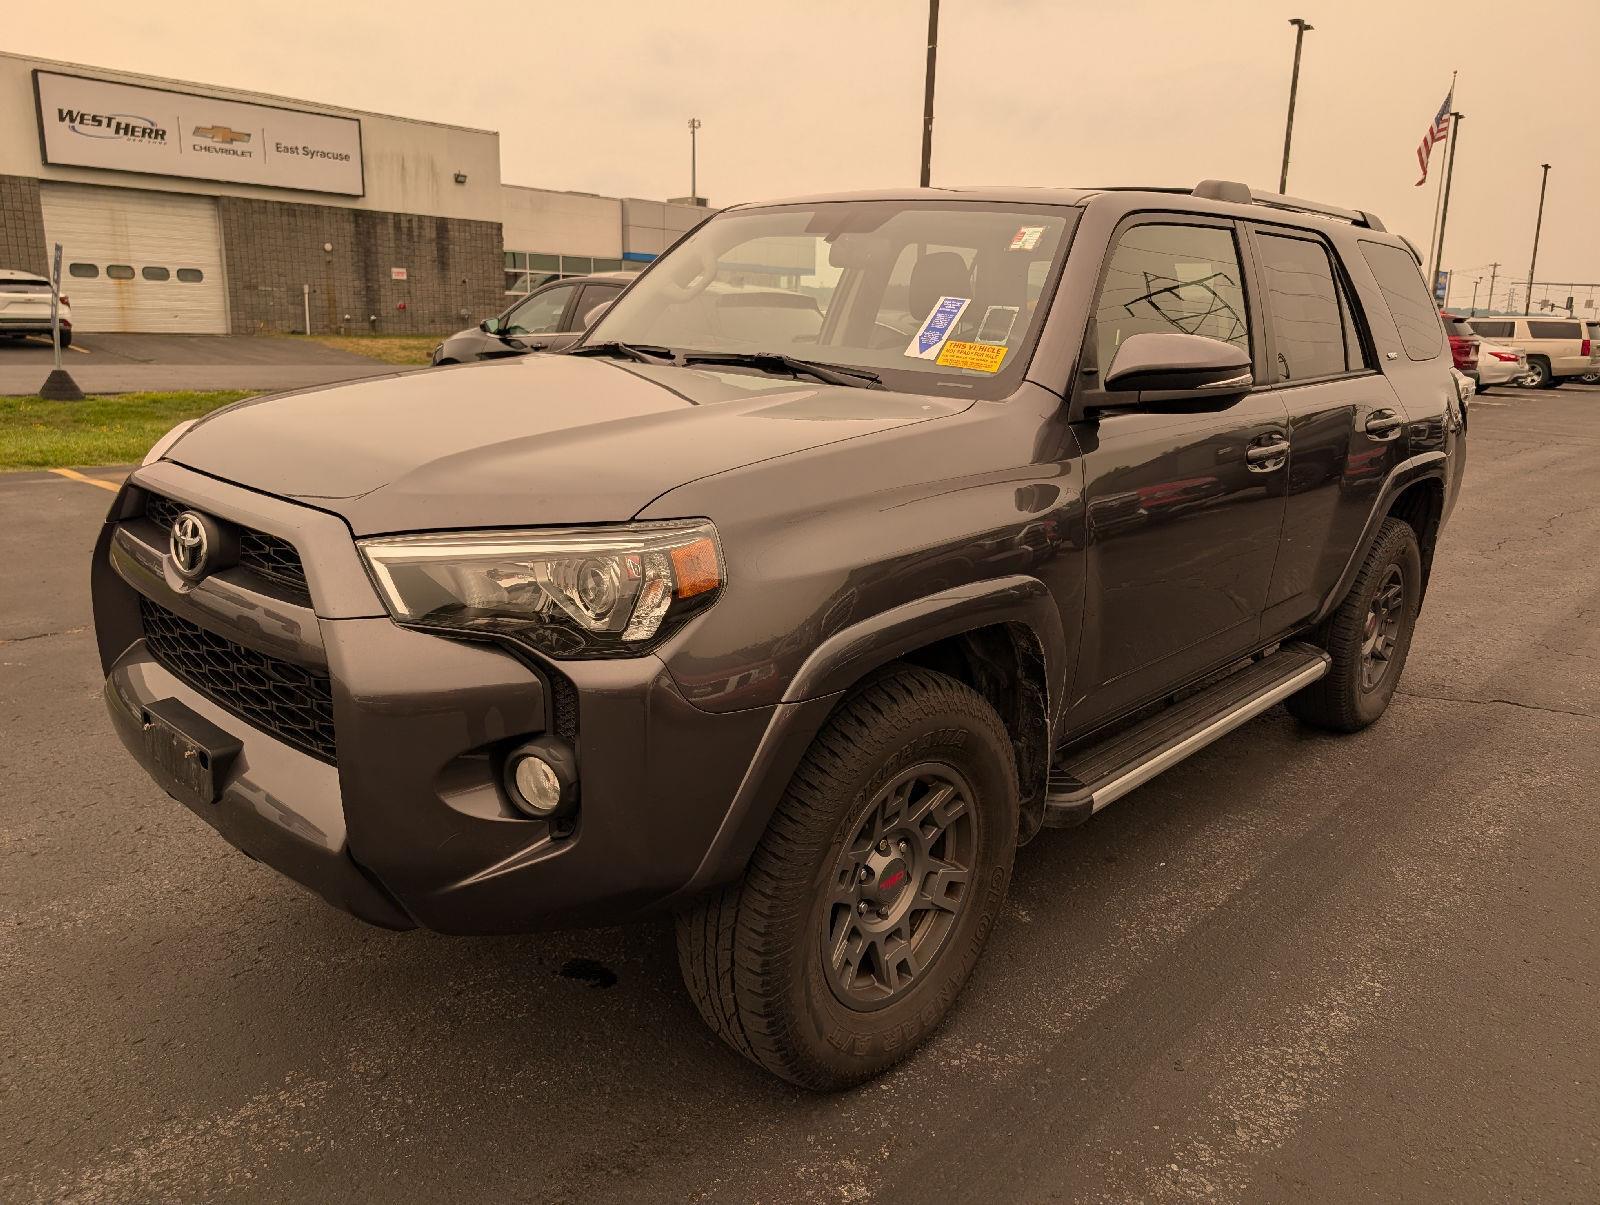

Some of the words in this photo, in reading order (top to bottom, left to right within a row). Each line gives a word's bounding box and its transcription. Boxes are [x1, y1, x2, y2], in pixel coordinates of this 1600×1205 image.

[57, 108, 117, 128] WEST
[114, 122, 167, 141] HERR
[192, 143, 253, 158] CHEVROLET
[275, 142, 300, 155] East
[302, 146, 351, 162] Syracuse
[949, 342, 967, 350] THIS
[968, 344, 1002, 355] VEHICLE
